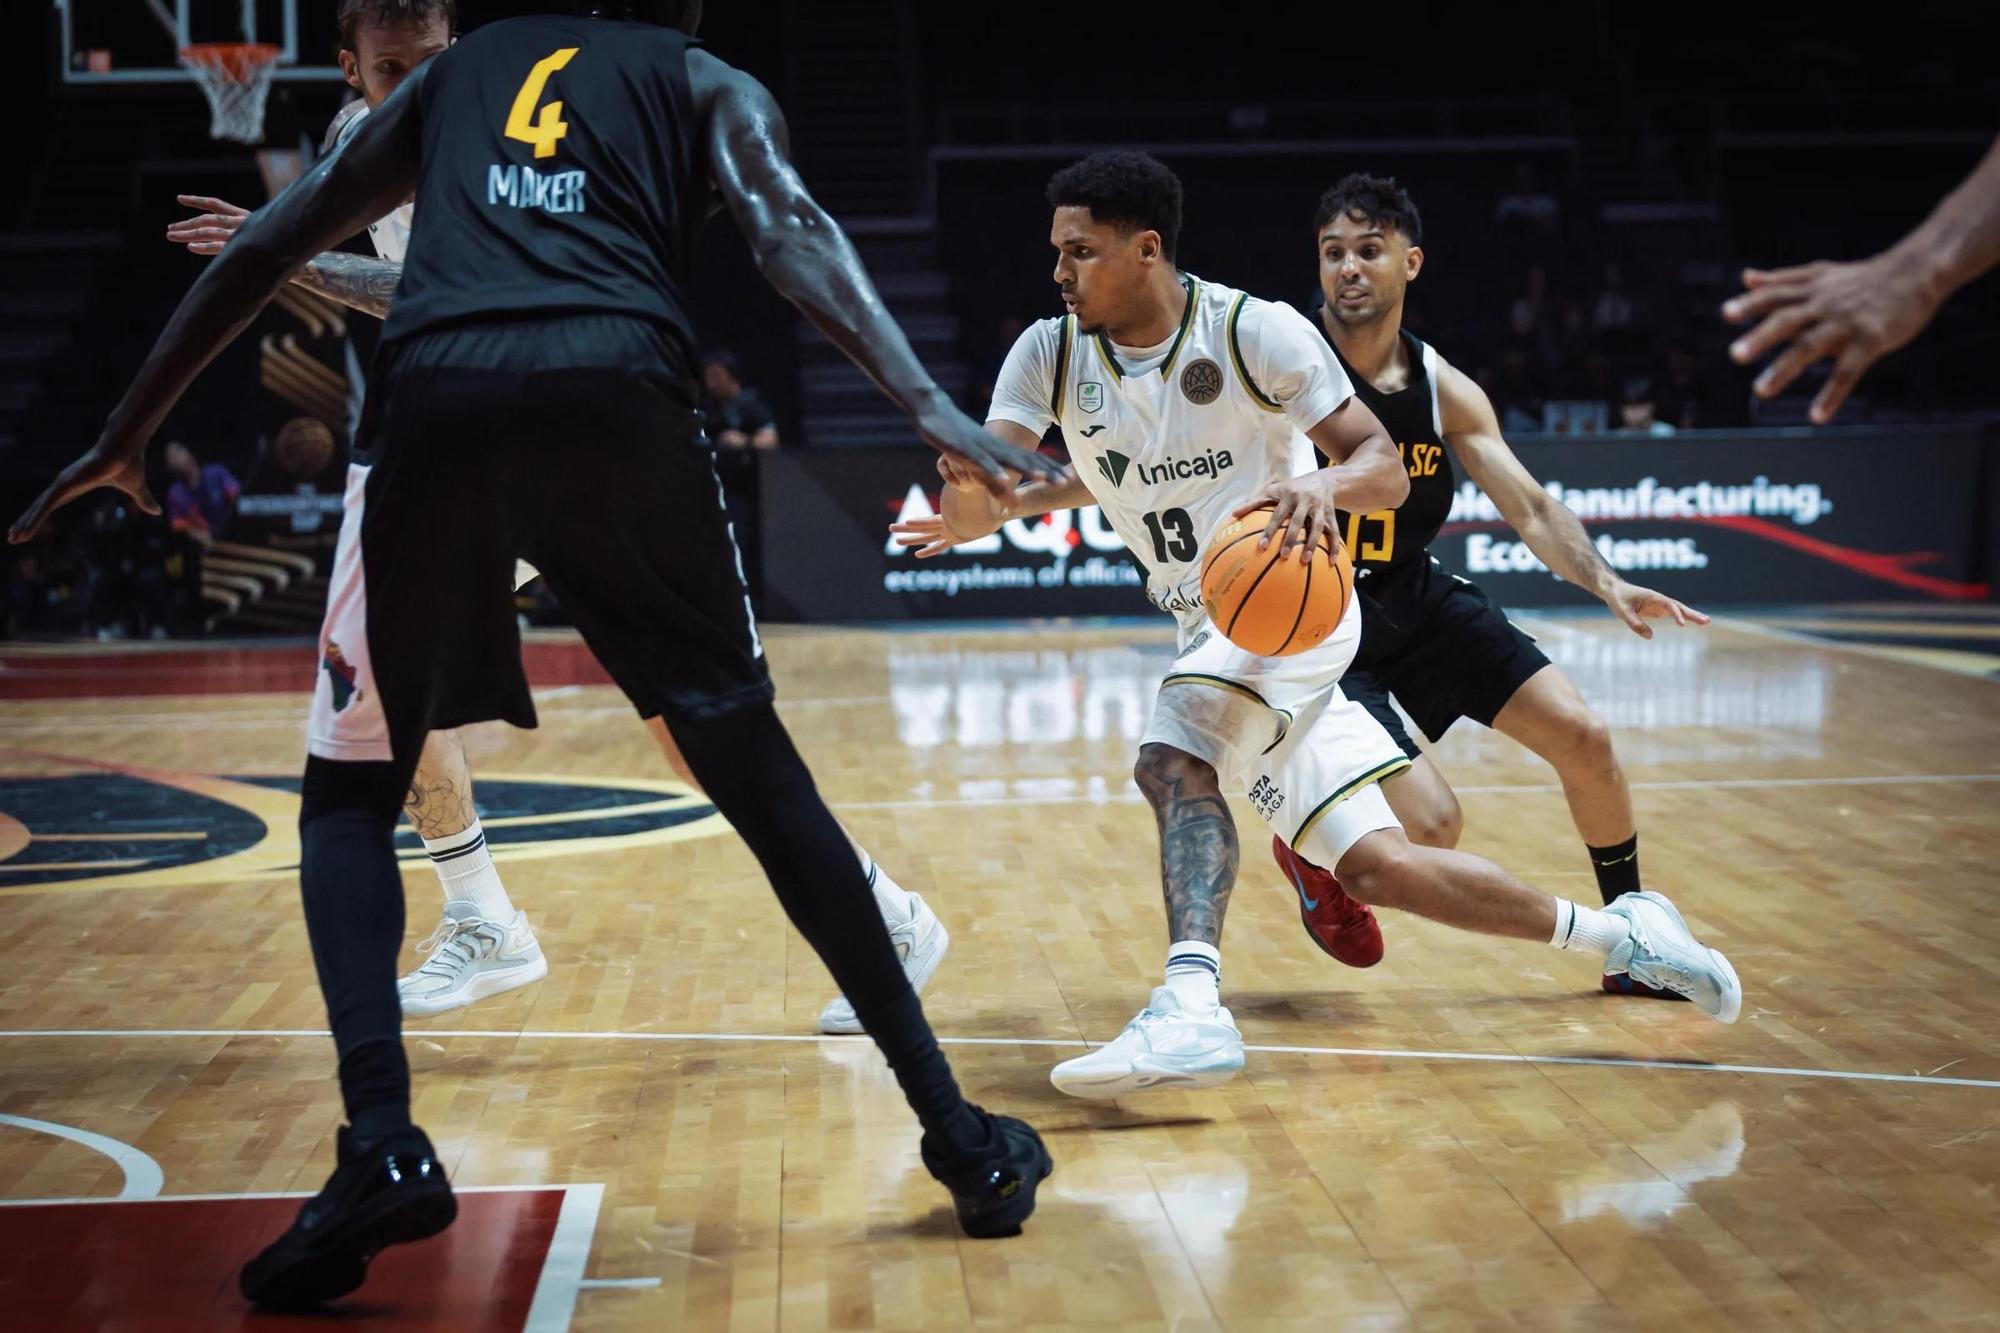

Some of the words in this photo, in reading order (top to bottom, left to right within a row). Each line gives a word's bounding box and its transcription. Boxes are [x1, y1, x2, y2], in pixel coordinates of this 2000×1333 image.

[504, 47, 580, 159] 4
[488, 164, 586, 213] MAKER
[1137, 448, 1234, 485] Unicaja
[1409, 443, 1442, 478] SC
[1142, 507, 1199, 563] 13
[884, 562, 1035, 596] ecosystems
[1037, 558, 1067, 587] of
[1248, 774, 1271, 804] OSTA
[1260, 786, 1280, 806] SOL
[1264, 794, 1286, 822] LAGA
